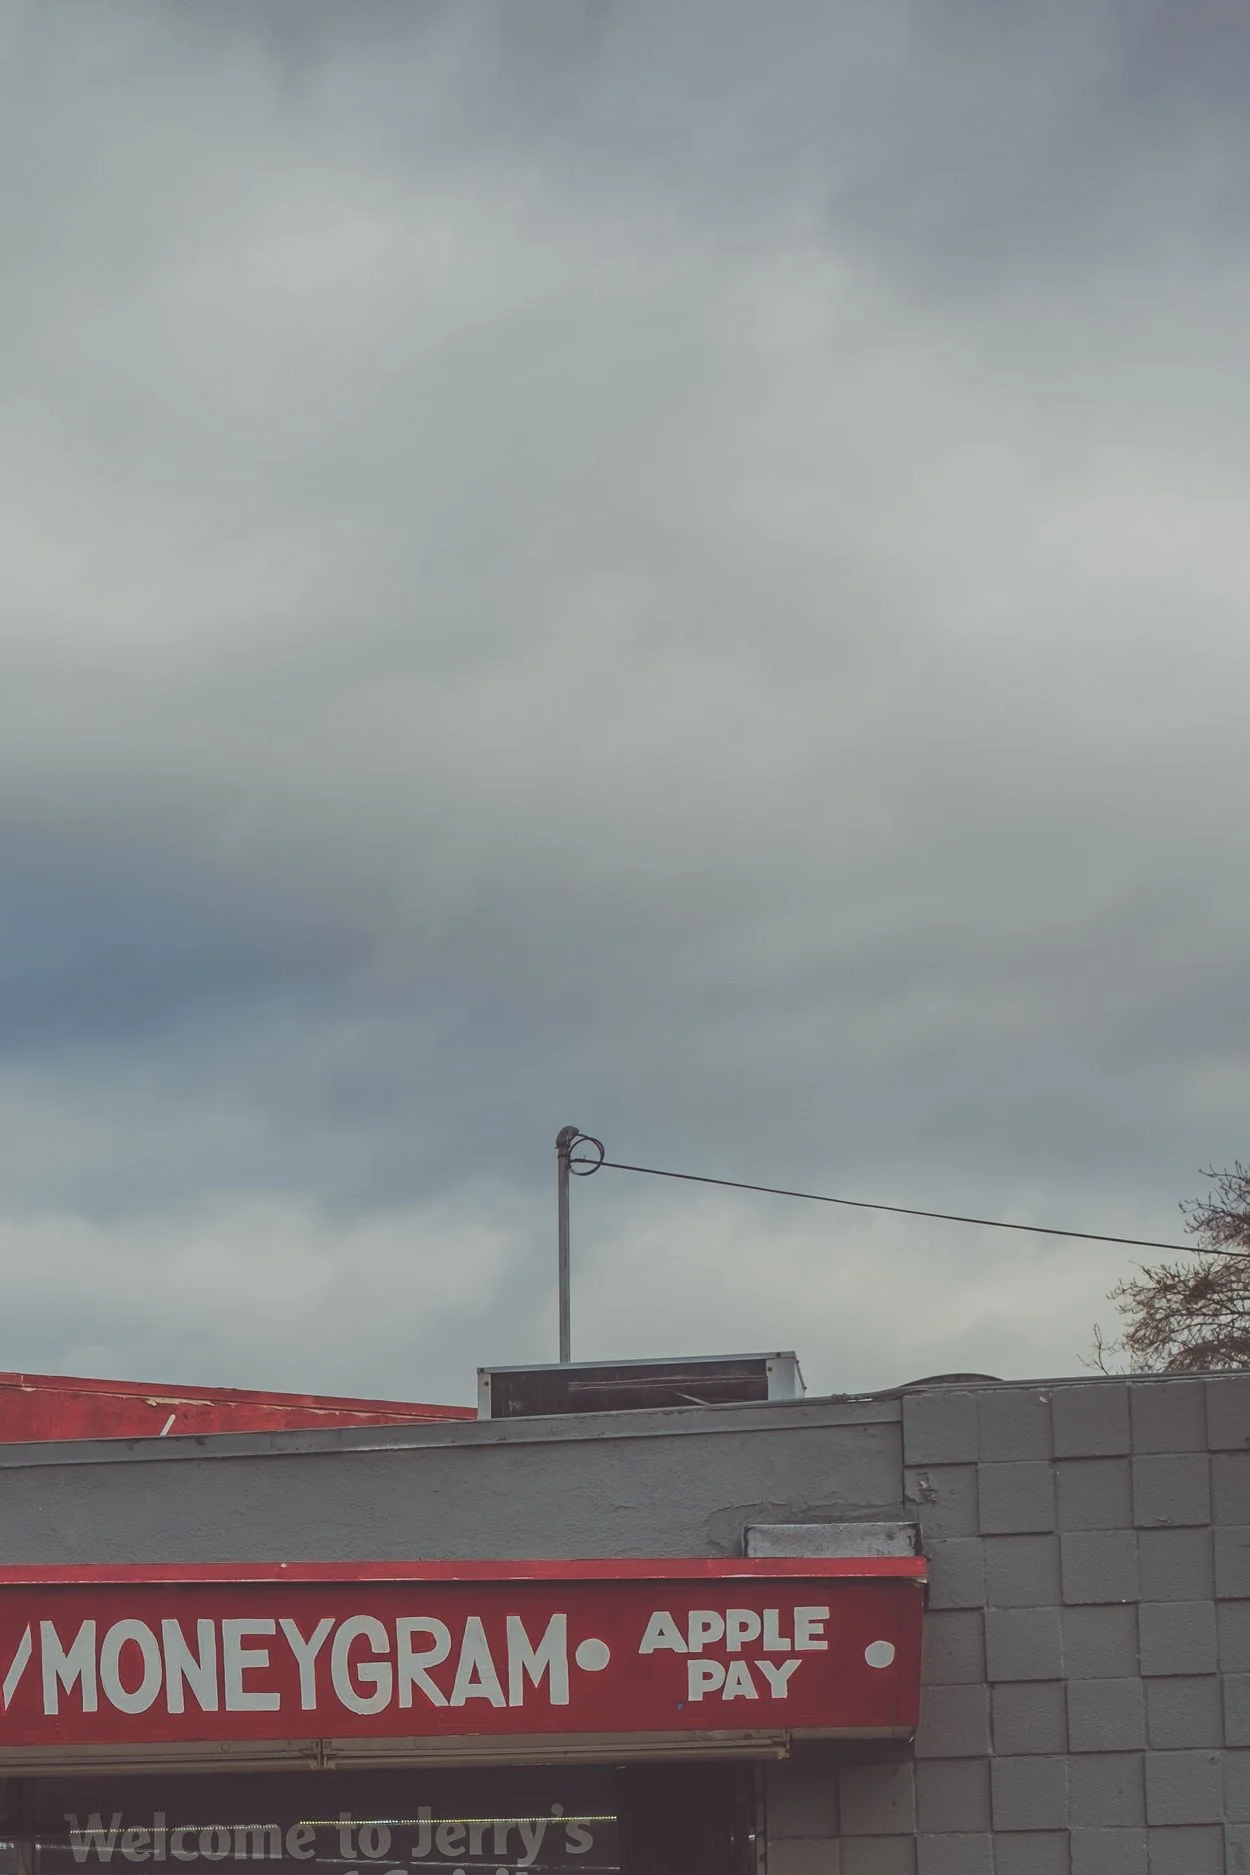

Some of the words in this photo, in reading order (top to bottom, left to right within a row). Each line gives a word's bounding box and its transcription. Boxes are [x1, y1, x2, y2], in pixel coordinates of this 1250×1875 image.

[639, 1606, 830, 1655] APPLE
[687, 1659, 802, 1702] PAY
[65, 1811, 316, 1865] Welcome
[338, 1813, 391, 1859] to
[410, 1803, 595, 1871] Jerry's
